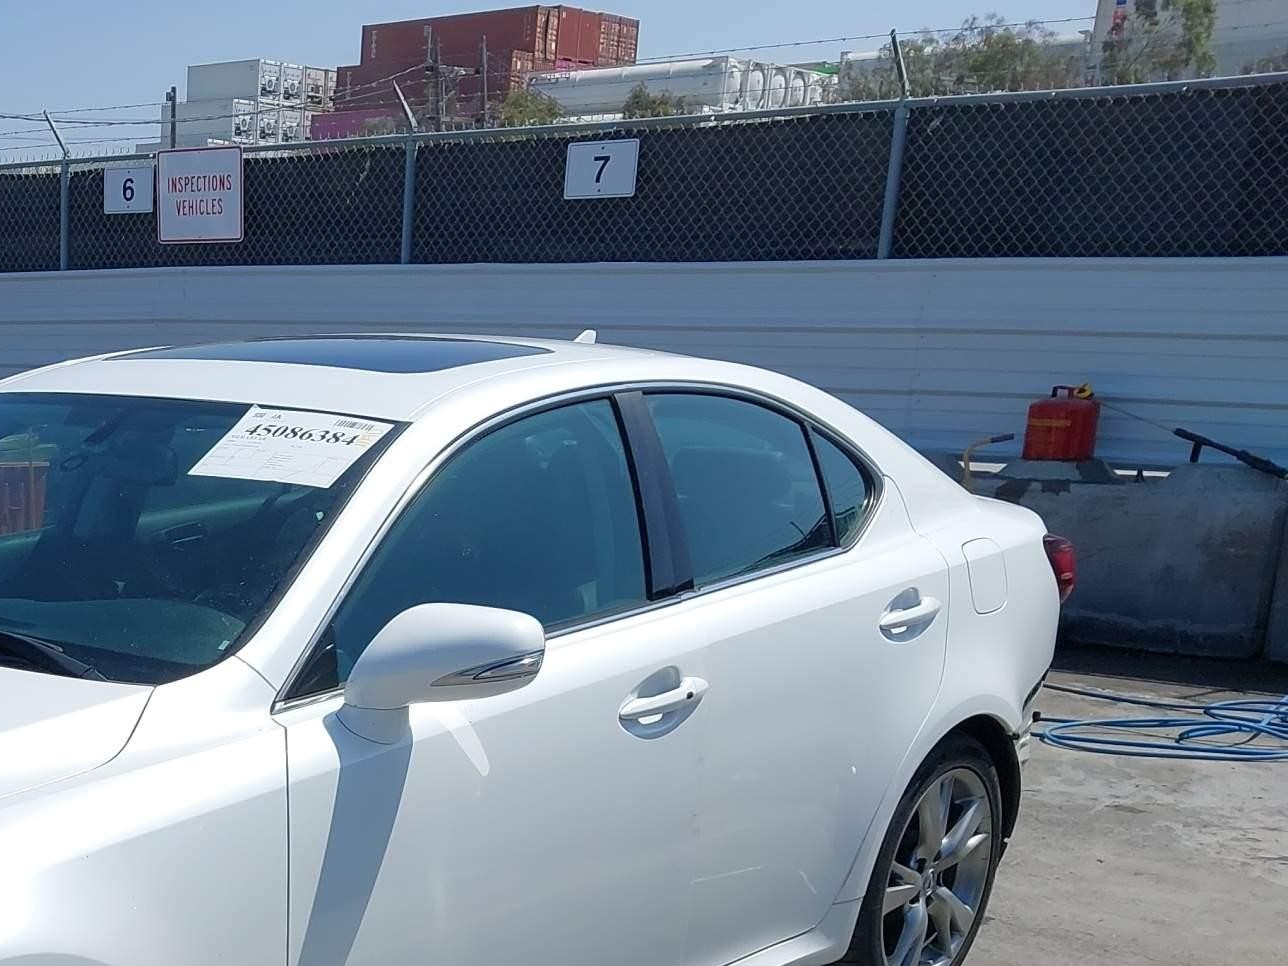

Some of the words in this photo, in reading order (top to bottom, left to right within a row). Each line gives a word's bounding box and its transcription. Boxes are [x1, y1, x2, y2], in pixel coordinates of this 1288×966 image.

[593, 155, 611, 184] 7
[122, 178, 135, 202] 6
[167, 174, 232, 194] INSPECTIONS
[175, 198, 223, 216] VEHICLES
[245, 423, 360, 446] 45086384
